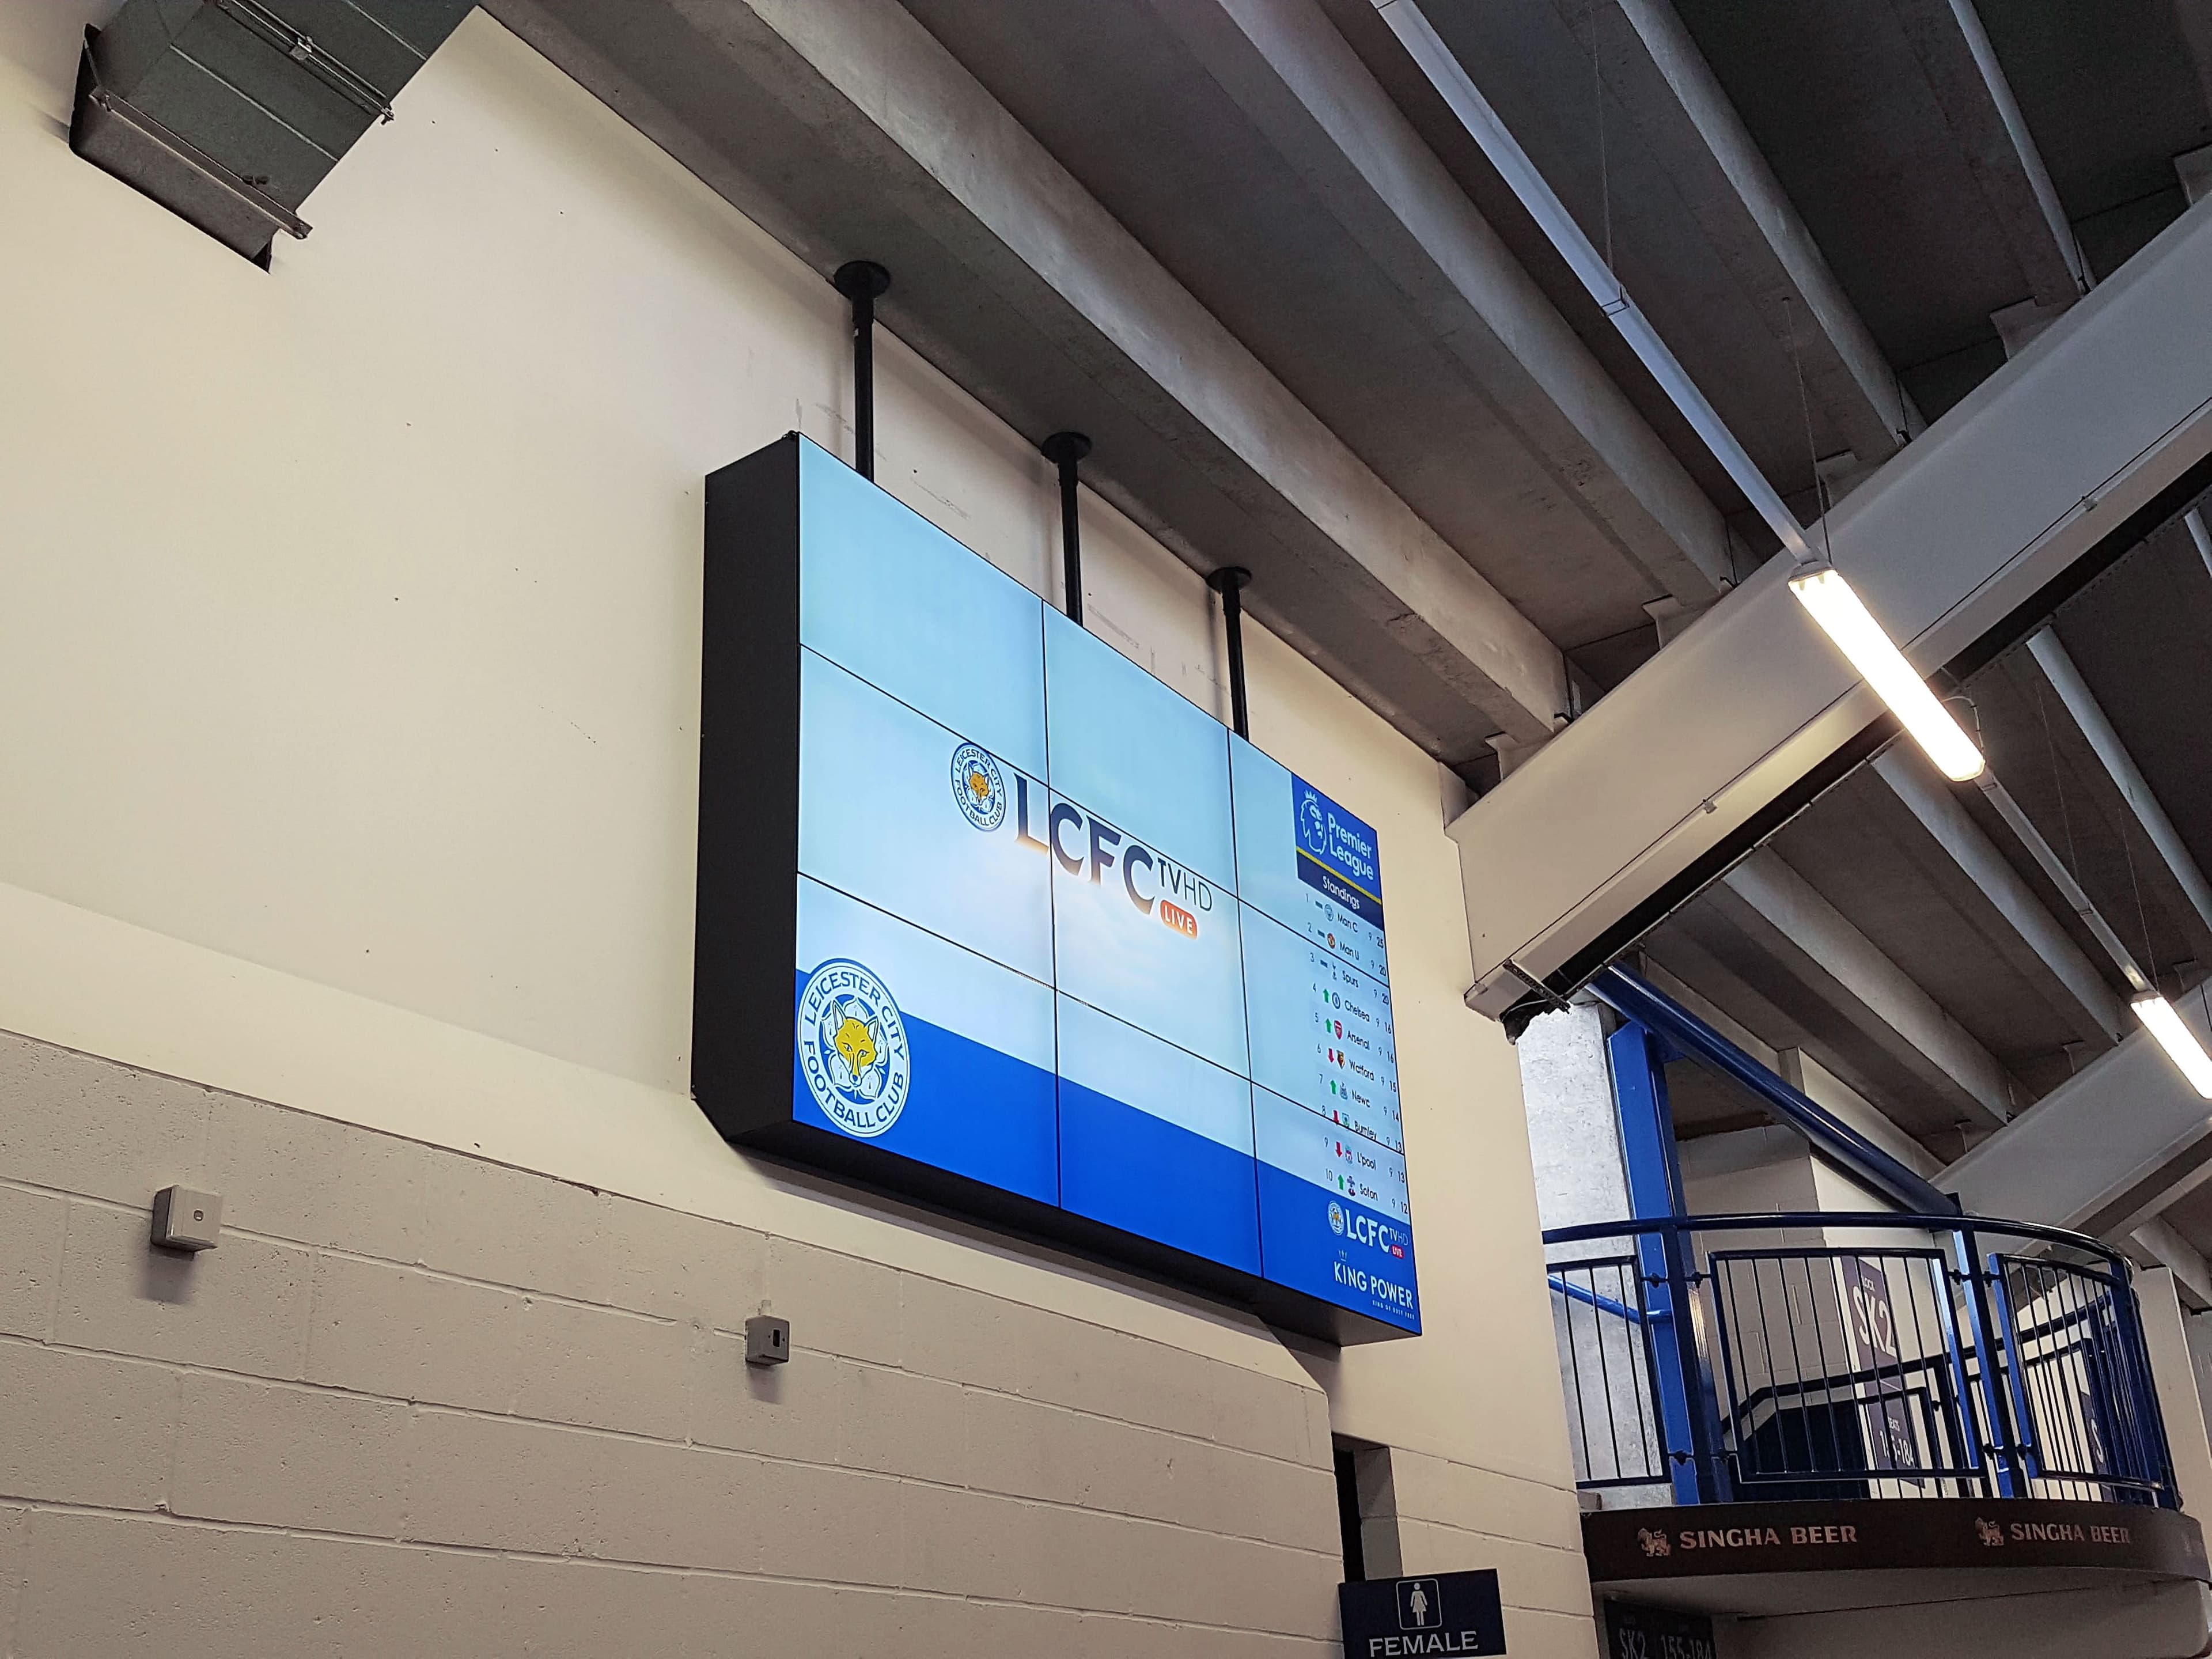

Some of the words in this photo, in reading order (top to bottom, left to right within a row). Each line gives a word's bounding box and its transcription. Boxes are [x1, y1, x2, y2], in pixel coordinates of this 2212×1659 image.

[955, 749, 991, 773] LEICESTER
[991, 768, 1002, 797] CITY
[955, 779, 990, 826] FOOTBALL
[989, 801, 1002, 825] CLUB
[1013, 772, 1156, 915] LCFC
[1327, 812, 1372, 859] Premier
[1329, 834, 1374, 881] League
[1323, 875, 1360, 910] Standings
[1164, 908, 1193, 934] LIVE
[1307, 922, 1312, 933] 2
[1340, 941, 1354, 957] Man
[1354, 949, 1359, 960] U
[1337, 912, 1352, 929] Man
[1352, 922, 1358, 933] C
[1310, 952, 1315, 962] 3
[1342, 970, 1359, 988] Spurs
[805, 971, 881, 1027] LEICESTER
[882, 1005, 904, 1060] CITY
[1315, 1012, 1319, 1022] 5
[1347, 1031, 1370, 1051] Arsenal
[1387, 1051, 1394, 1063] 16
[1344, 1000, 1370, 1022] Chelsea
[1385, 1022, 1392, 1034] 16
[804, 1040, 876, 1128] FOOTBALL
[876, 1071, 904, 1123] CLUB
[1317, 1043, 1321, 1054] 6
[1349, 1059, 1374, 1081] Watford
[1389, 1080, 1397, 1093] 15
[1319, 1073, 1323, 1084] 7
[1351, 1089, 1370, 1108] Newc
[1354, 1120, 1377, 1141] Burnley
[1324, 1137, 1328, 1148] 9
[1398, 1171, 1405, 1183] 13
[1325, 1168, 1333, 1181] 10
[1401, 1201, 1408, 1214] 12
[1345, 1209, 1389, 1253] LCFC
[1334, 1261, 1367, 1292] KING
[1370, 1275, 1414, 1310] POWER
[1853, 1285, 1897, 1358] SK2
[1680, 1527, 1781, 1550] SINGHA
[1790, 1525, 1857, 1544] BEER
[2010, 1523, 2085, 1542] SINGHA
[2090, 1525, 2131, 1544] BEER
[1369, 1631, 1479, 1657] FEMALE
